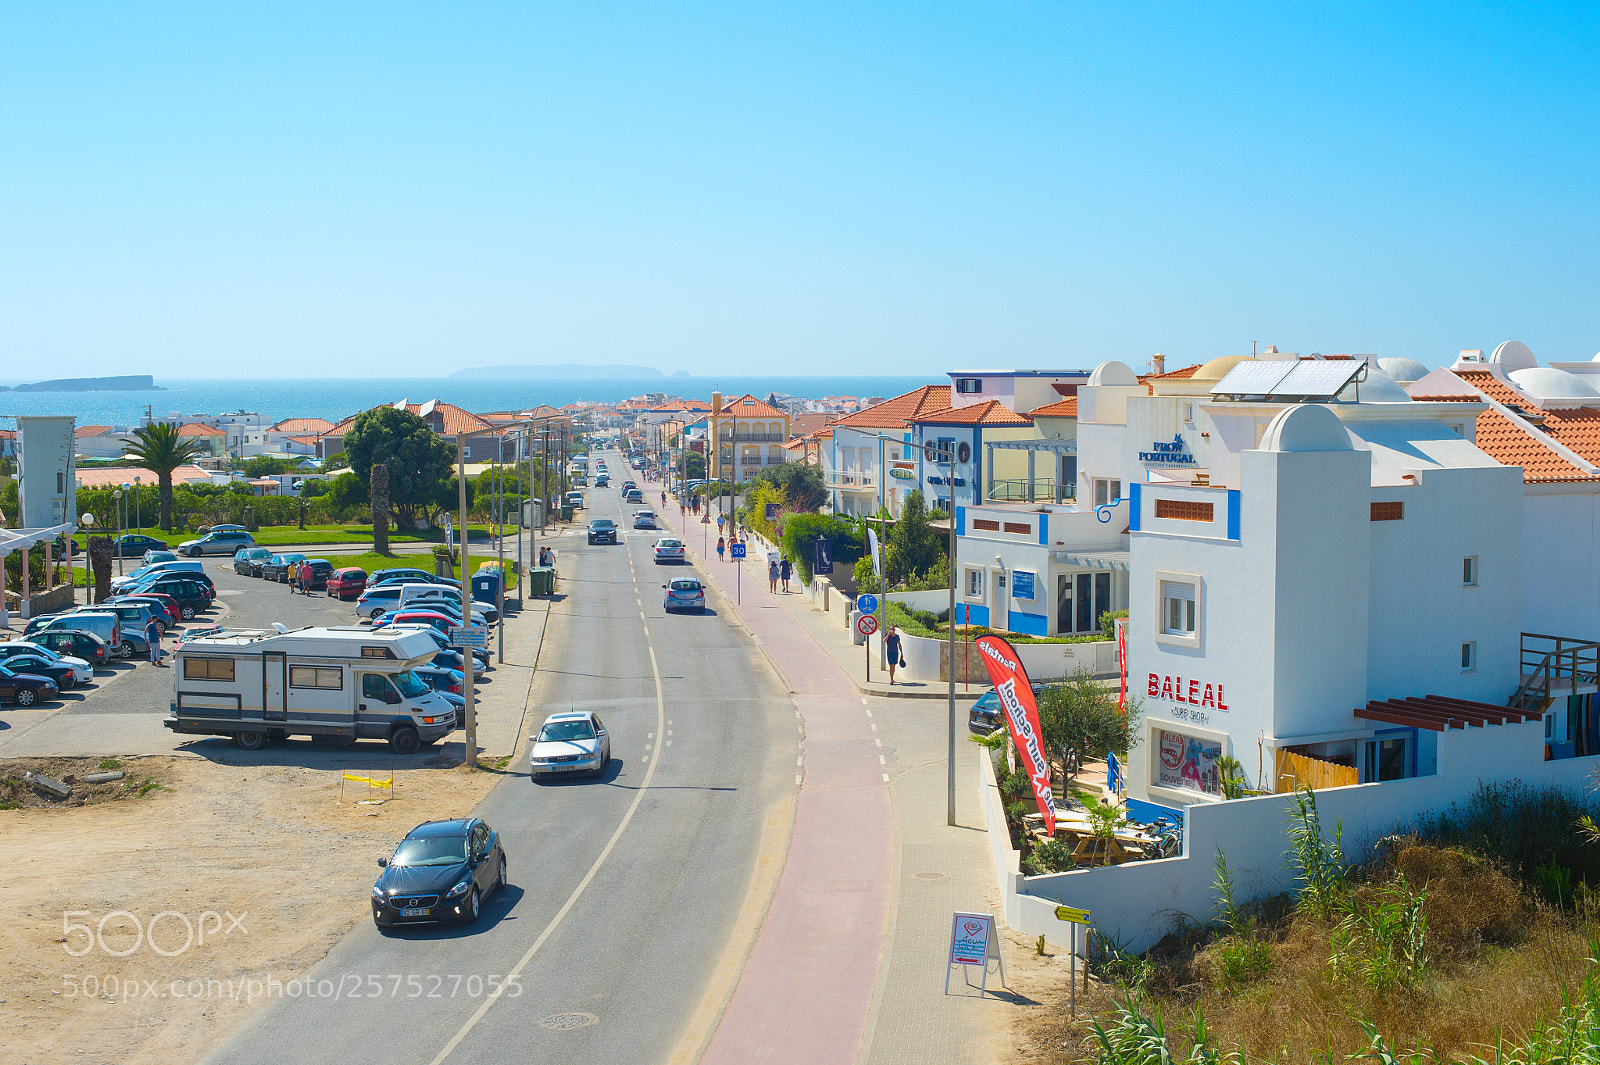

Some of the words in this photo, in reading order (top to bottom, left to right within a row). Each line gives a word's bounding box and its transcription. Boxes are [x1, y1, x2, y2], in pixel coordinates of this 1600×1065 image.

[1138, 451, 1196, 464] PORTUGAL
[734, 546, 745, 555] 30
[1147, 672, 1229, 711] BALEAL
[1173, 706, 1188, 717] SURF
[1189, 709, 1205, 721] SHOP
[1160, 730, 1184, 745] BALEAL
